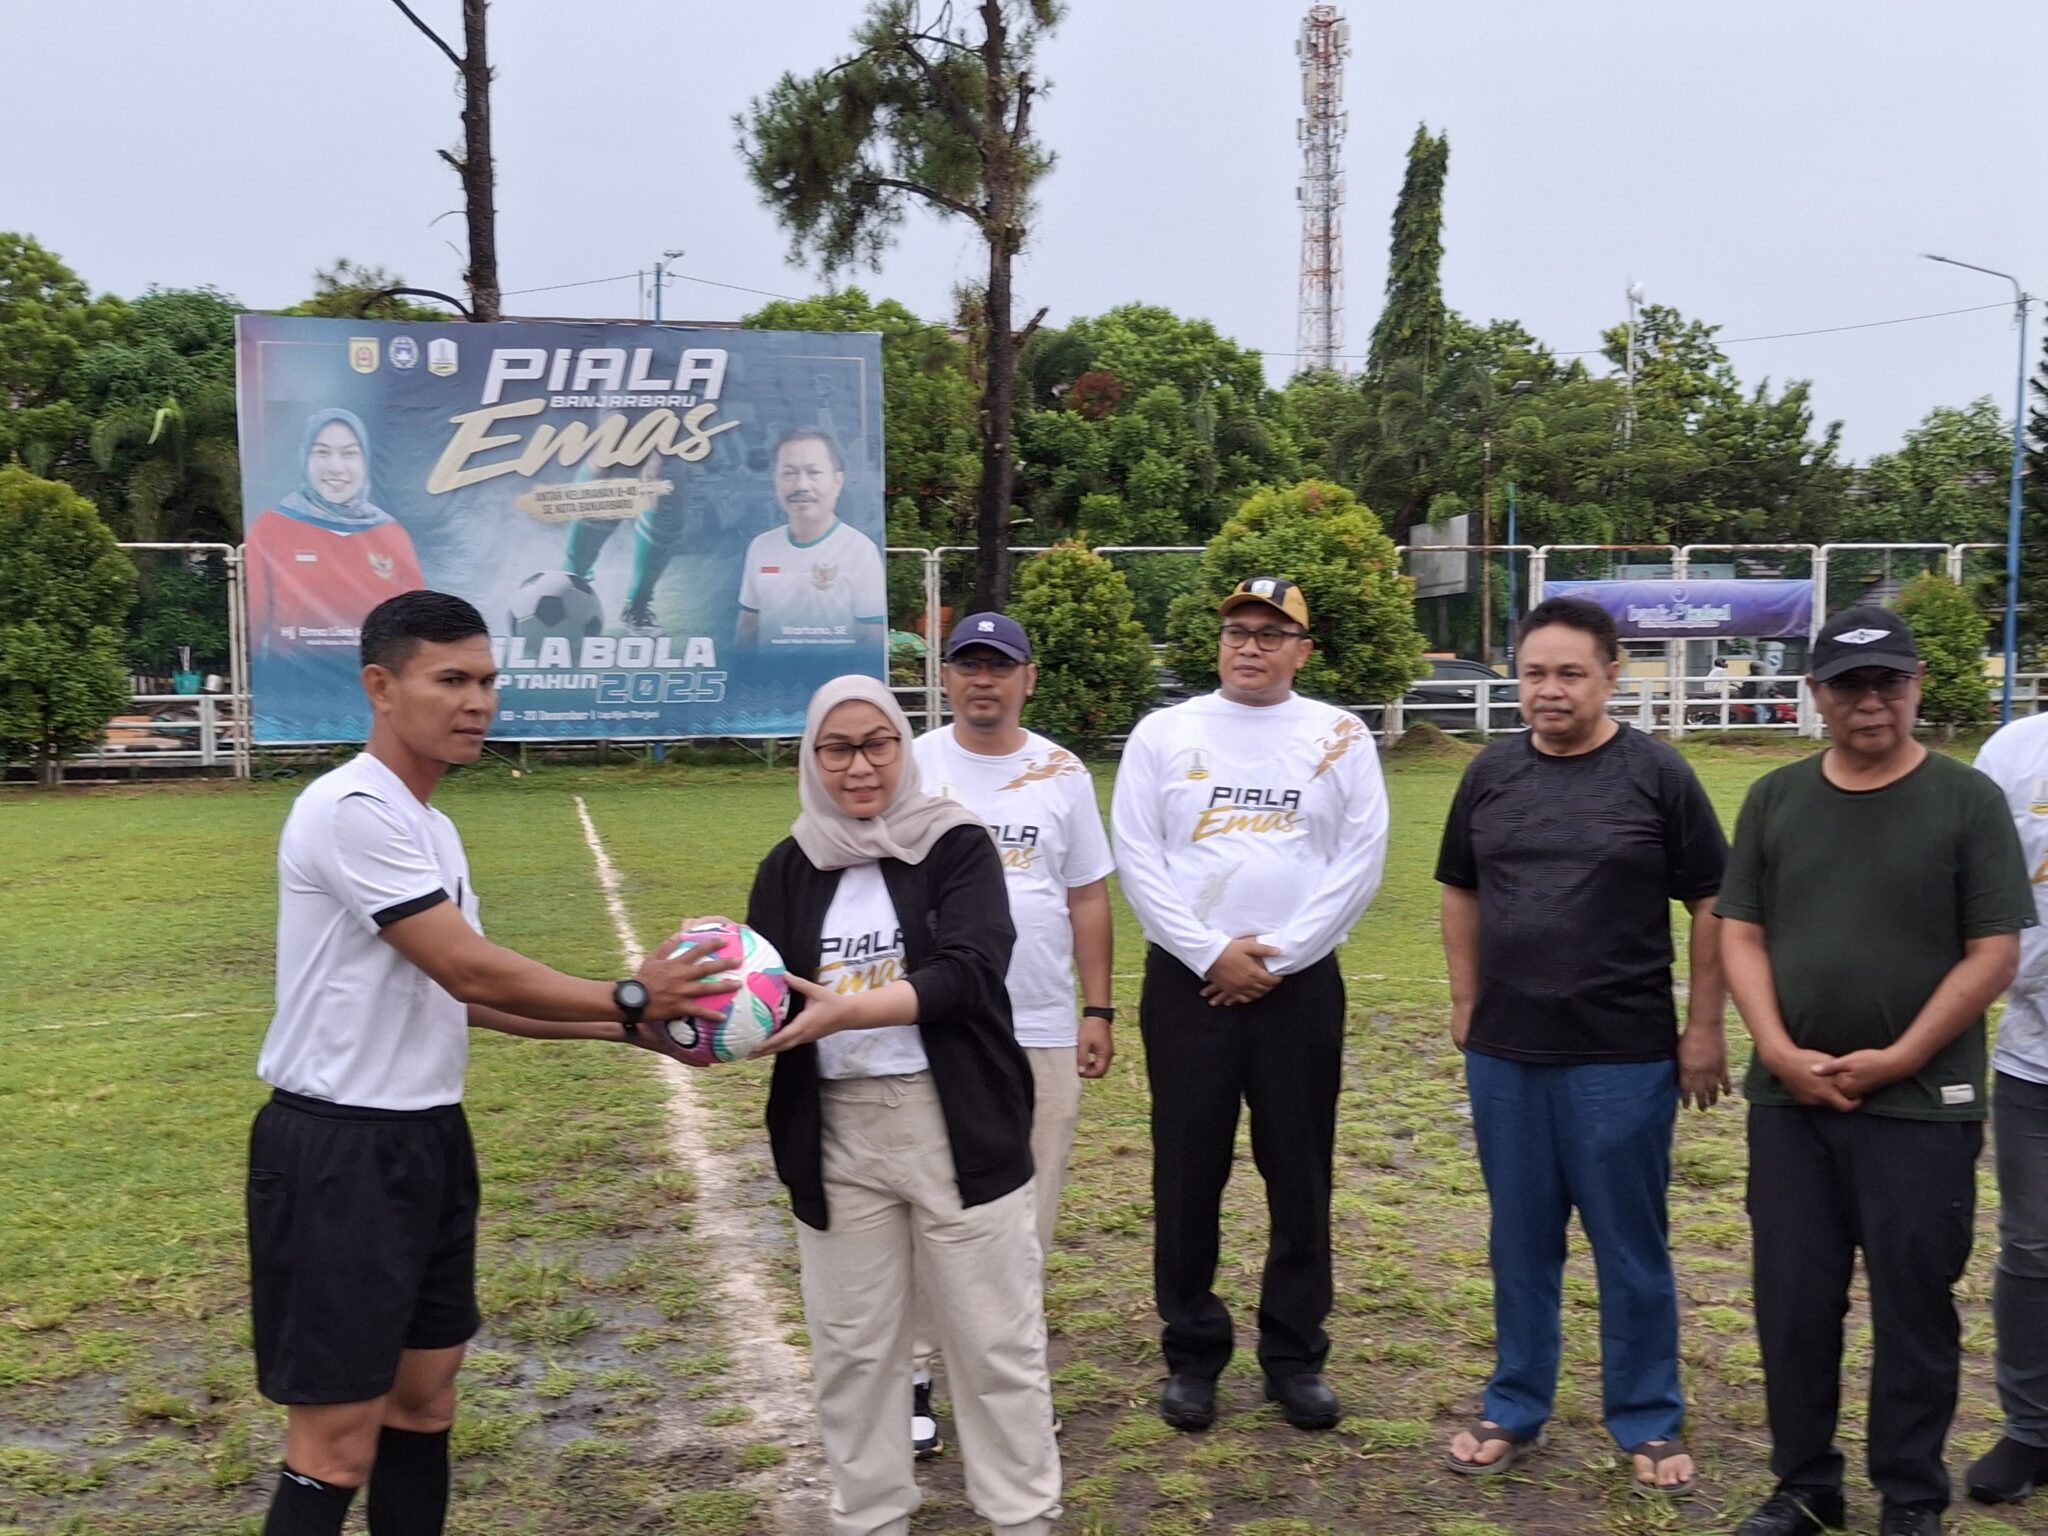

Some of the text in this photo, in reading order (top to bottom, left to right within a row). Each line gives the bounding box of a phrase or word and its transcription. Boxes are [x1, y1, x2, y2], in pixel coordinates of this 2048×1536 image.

[480, 347, 729, 405] PIALA
[549, 395, 698, 408] BANJARBARU
[425, 397, 742, 495] Emas
[579, 636, 717, 669] BOLA
[514, 673, 598, 690] TAHUN
[596, 671, 728, 704] 2025
[1208, 786, 1302, 811] PIALA
[1192, 805, 1306, 842] Emas
